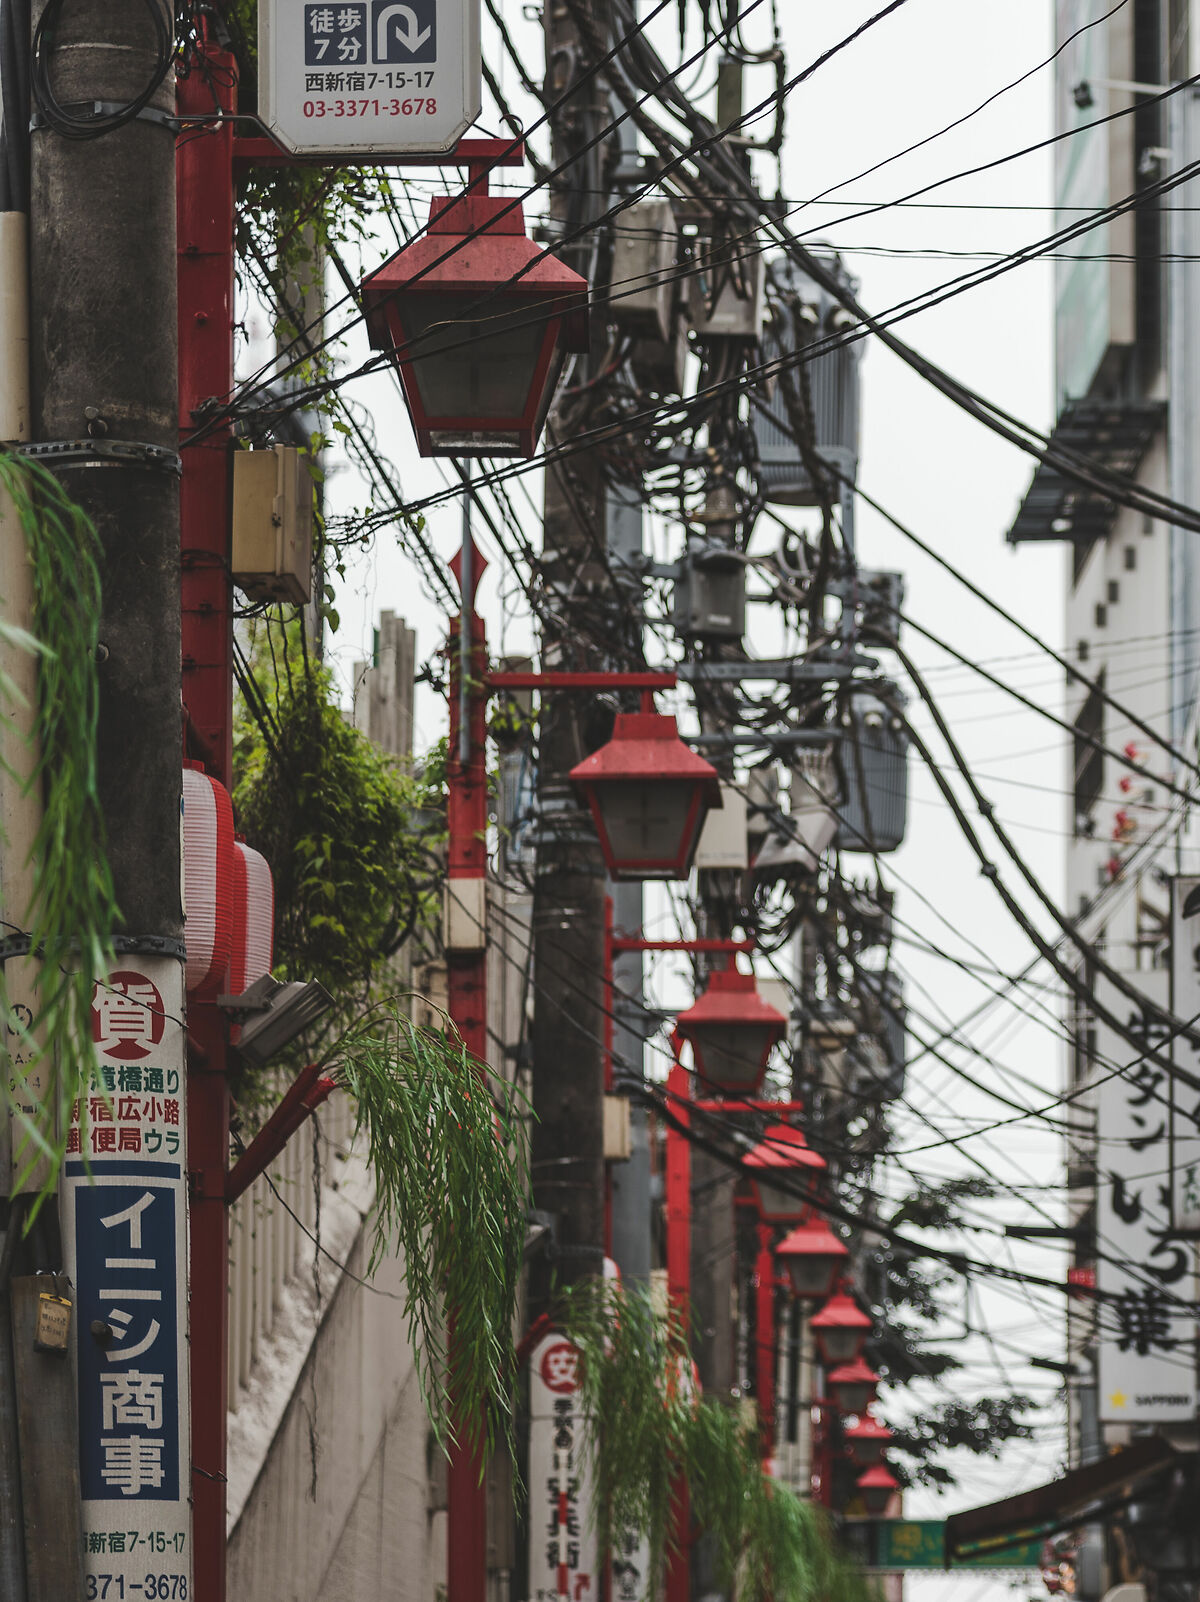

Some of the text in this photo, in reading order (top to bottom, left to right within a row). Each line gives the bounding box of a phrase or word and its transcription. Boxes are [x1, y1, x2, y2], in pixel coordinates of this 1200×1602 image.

[310, 8, 361, 33] 徒歩
[313, 37, 362, 61] 7分
[304, 71, 435, 92] 西新宿7-15-17
[303, 97, 437, 118] 03-3371-3678
[92, 982, 161, 1053] 質
[76, 1065, 180, 1094] 滝橋通り
[66, 1127, 180, 1155] 郵便局ウラ
[98, 1191, 166, 1496] イニシ商事
